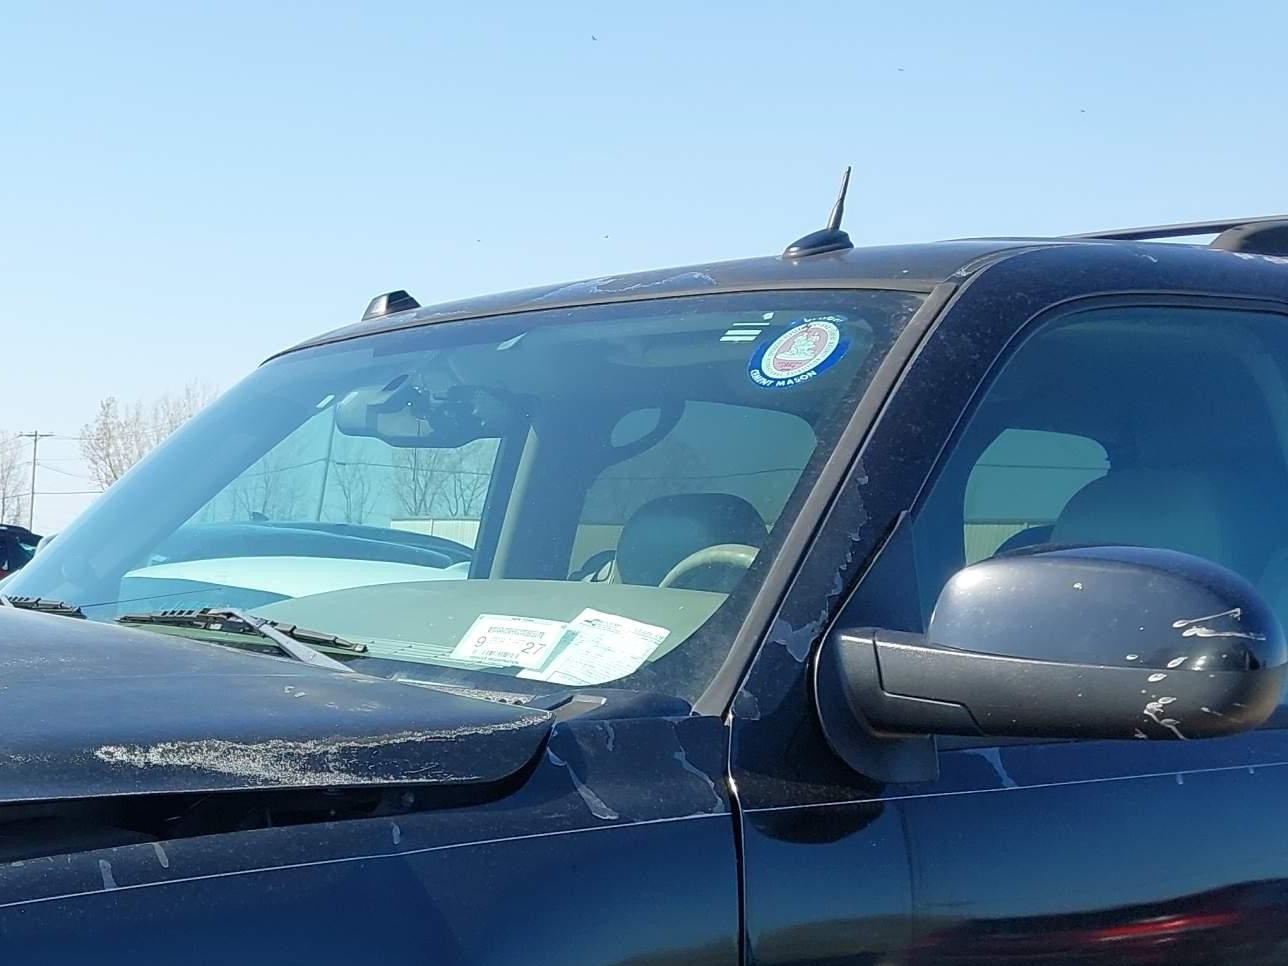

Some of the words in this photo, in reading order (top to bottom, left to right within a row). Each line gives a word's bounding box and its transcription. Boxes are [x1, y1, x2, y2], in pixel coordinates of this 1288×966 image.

[775, 370, 817, 387] MASON
[474, 636, 487, 648] 9
[521, 642, 546, 656] 27
